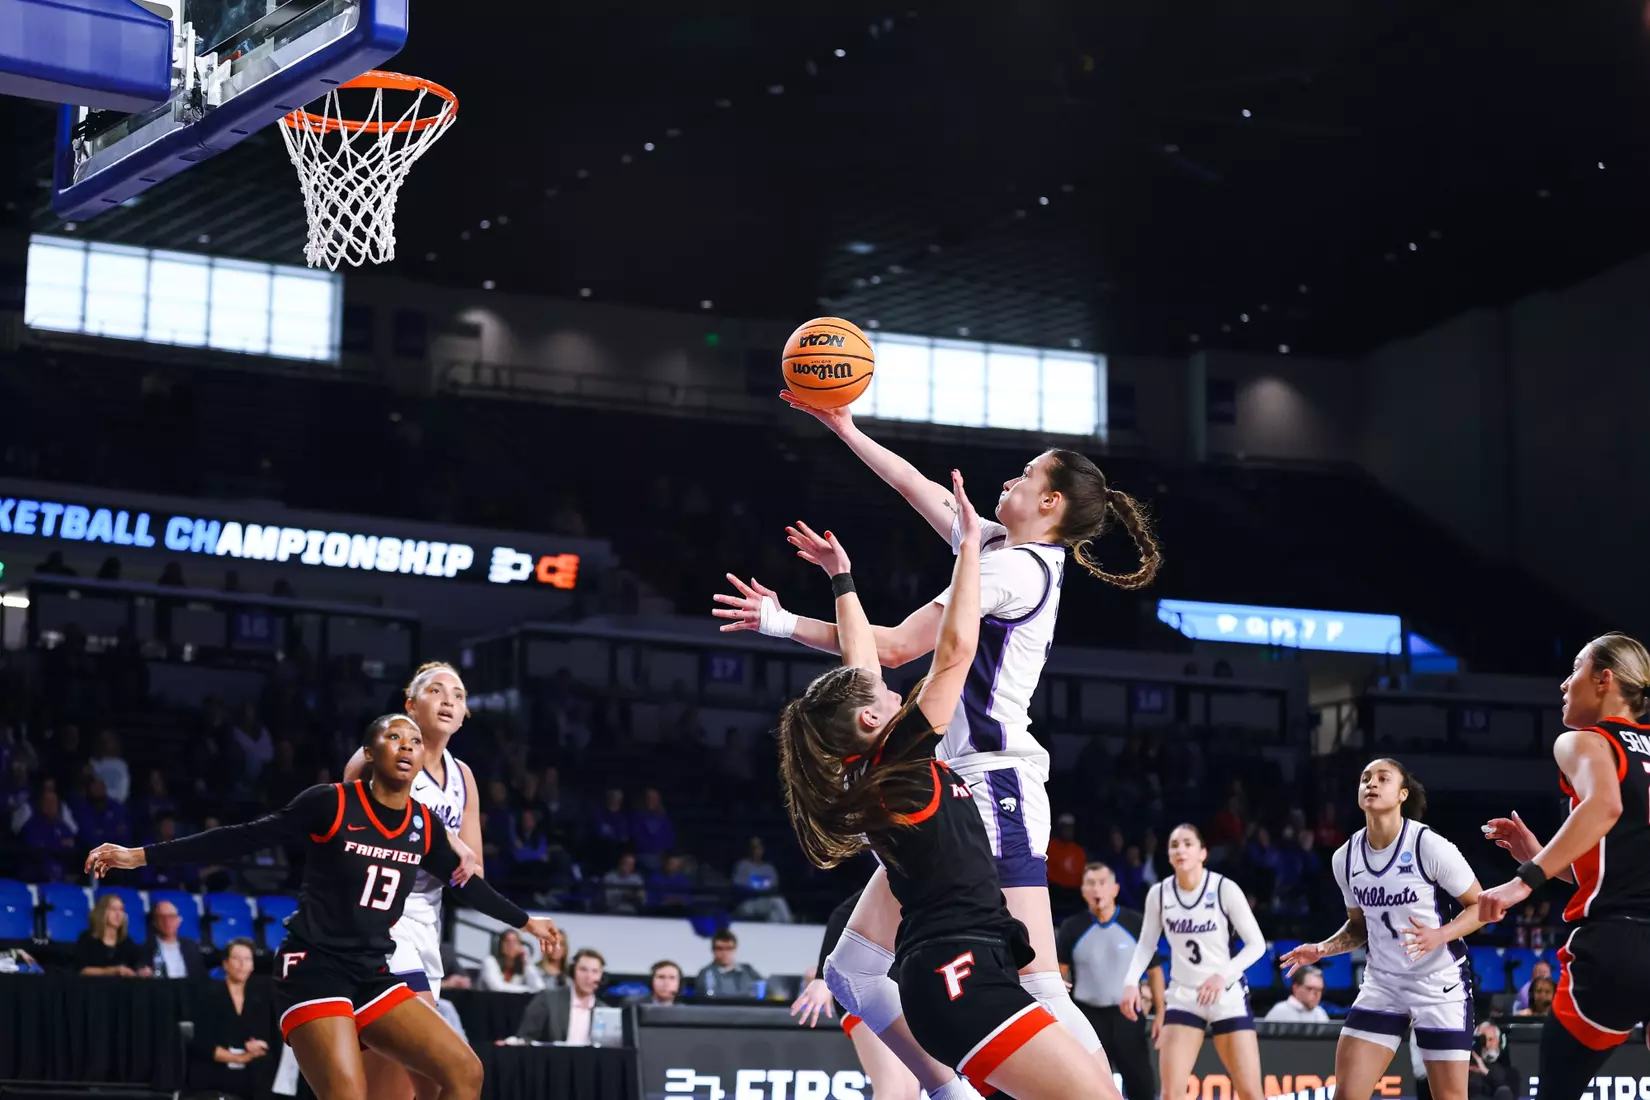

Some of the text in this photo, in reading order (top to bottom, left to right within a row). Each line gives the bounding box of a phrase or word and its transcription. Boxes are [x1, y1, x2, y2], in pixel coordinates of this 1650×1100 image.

[800, 333, 845, 348] NCAA
[793, 363, 853, 380] Wilson
[164, 514, 474, 579] CHAMPIONSHIP
[344, 840, 421, 865] FAIRFIELD
[359, 864, 401, 911] 13
[1353, 886, 1419, 908] Wildcats
[1166, 918, 1218, 935] Wildcats
[1381, 911, 1399, 940] 1
[282, 951, 308, 980] F
[1185, 939, 1202, 965] 3
[934, 950, 976, 1002] F
[735, 1069, 873, 1100] FIRS
